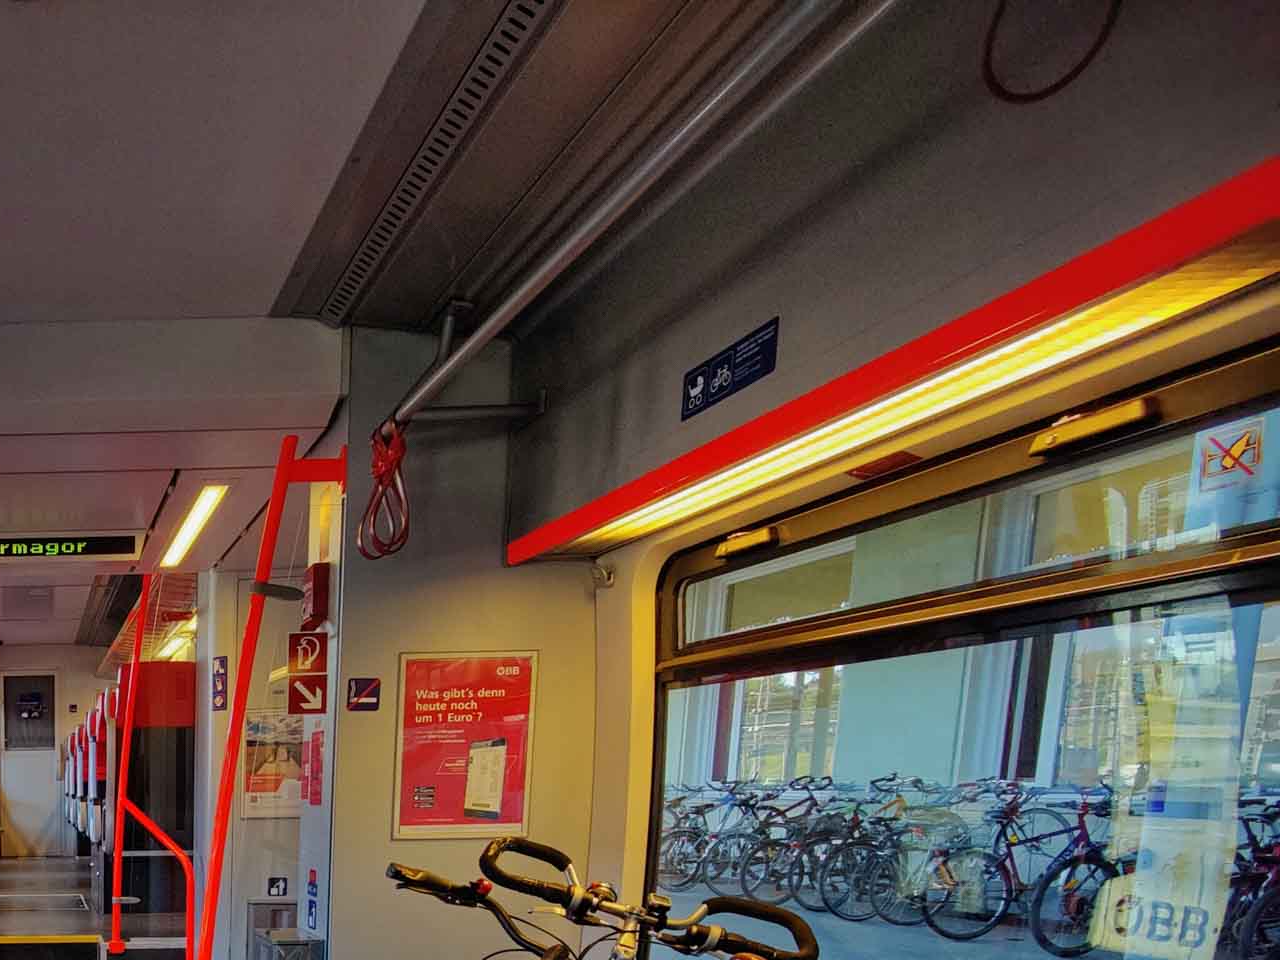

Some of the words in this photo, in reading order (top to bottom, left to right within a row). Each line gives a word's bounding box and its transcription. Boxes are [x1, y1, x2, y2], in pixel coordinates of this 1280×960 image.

[415, 689, 439, 699] Was
[477, 687, 506, 697] denn
[415, 701, 447, 711] heute
[450, 700, 478, 710] noch
[415, 714, 432, 723] um
[438, 713, 443, 722] 1
